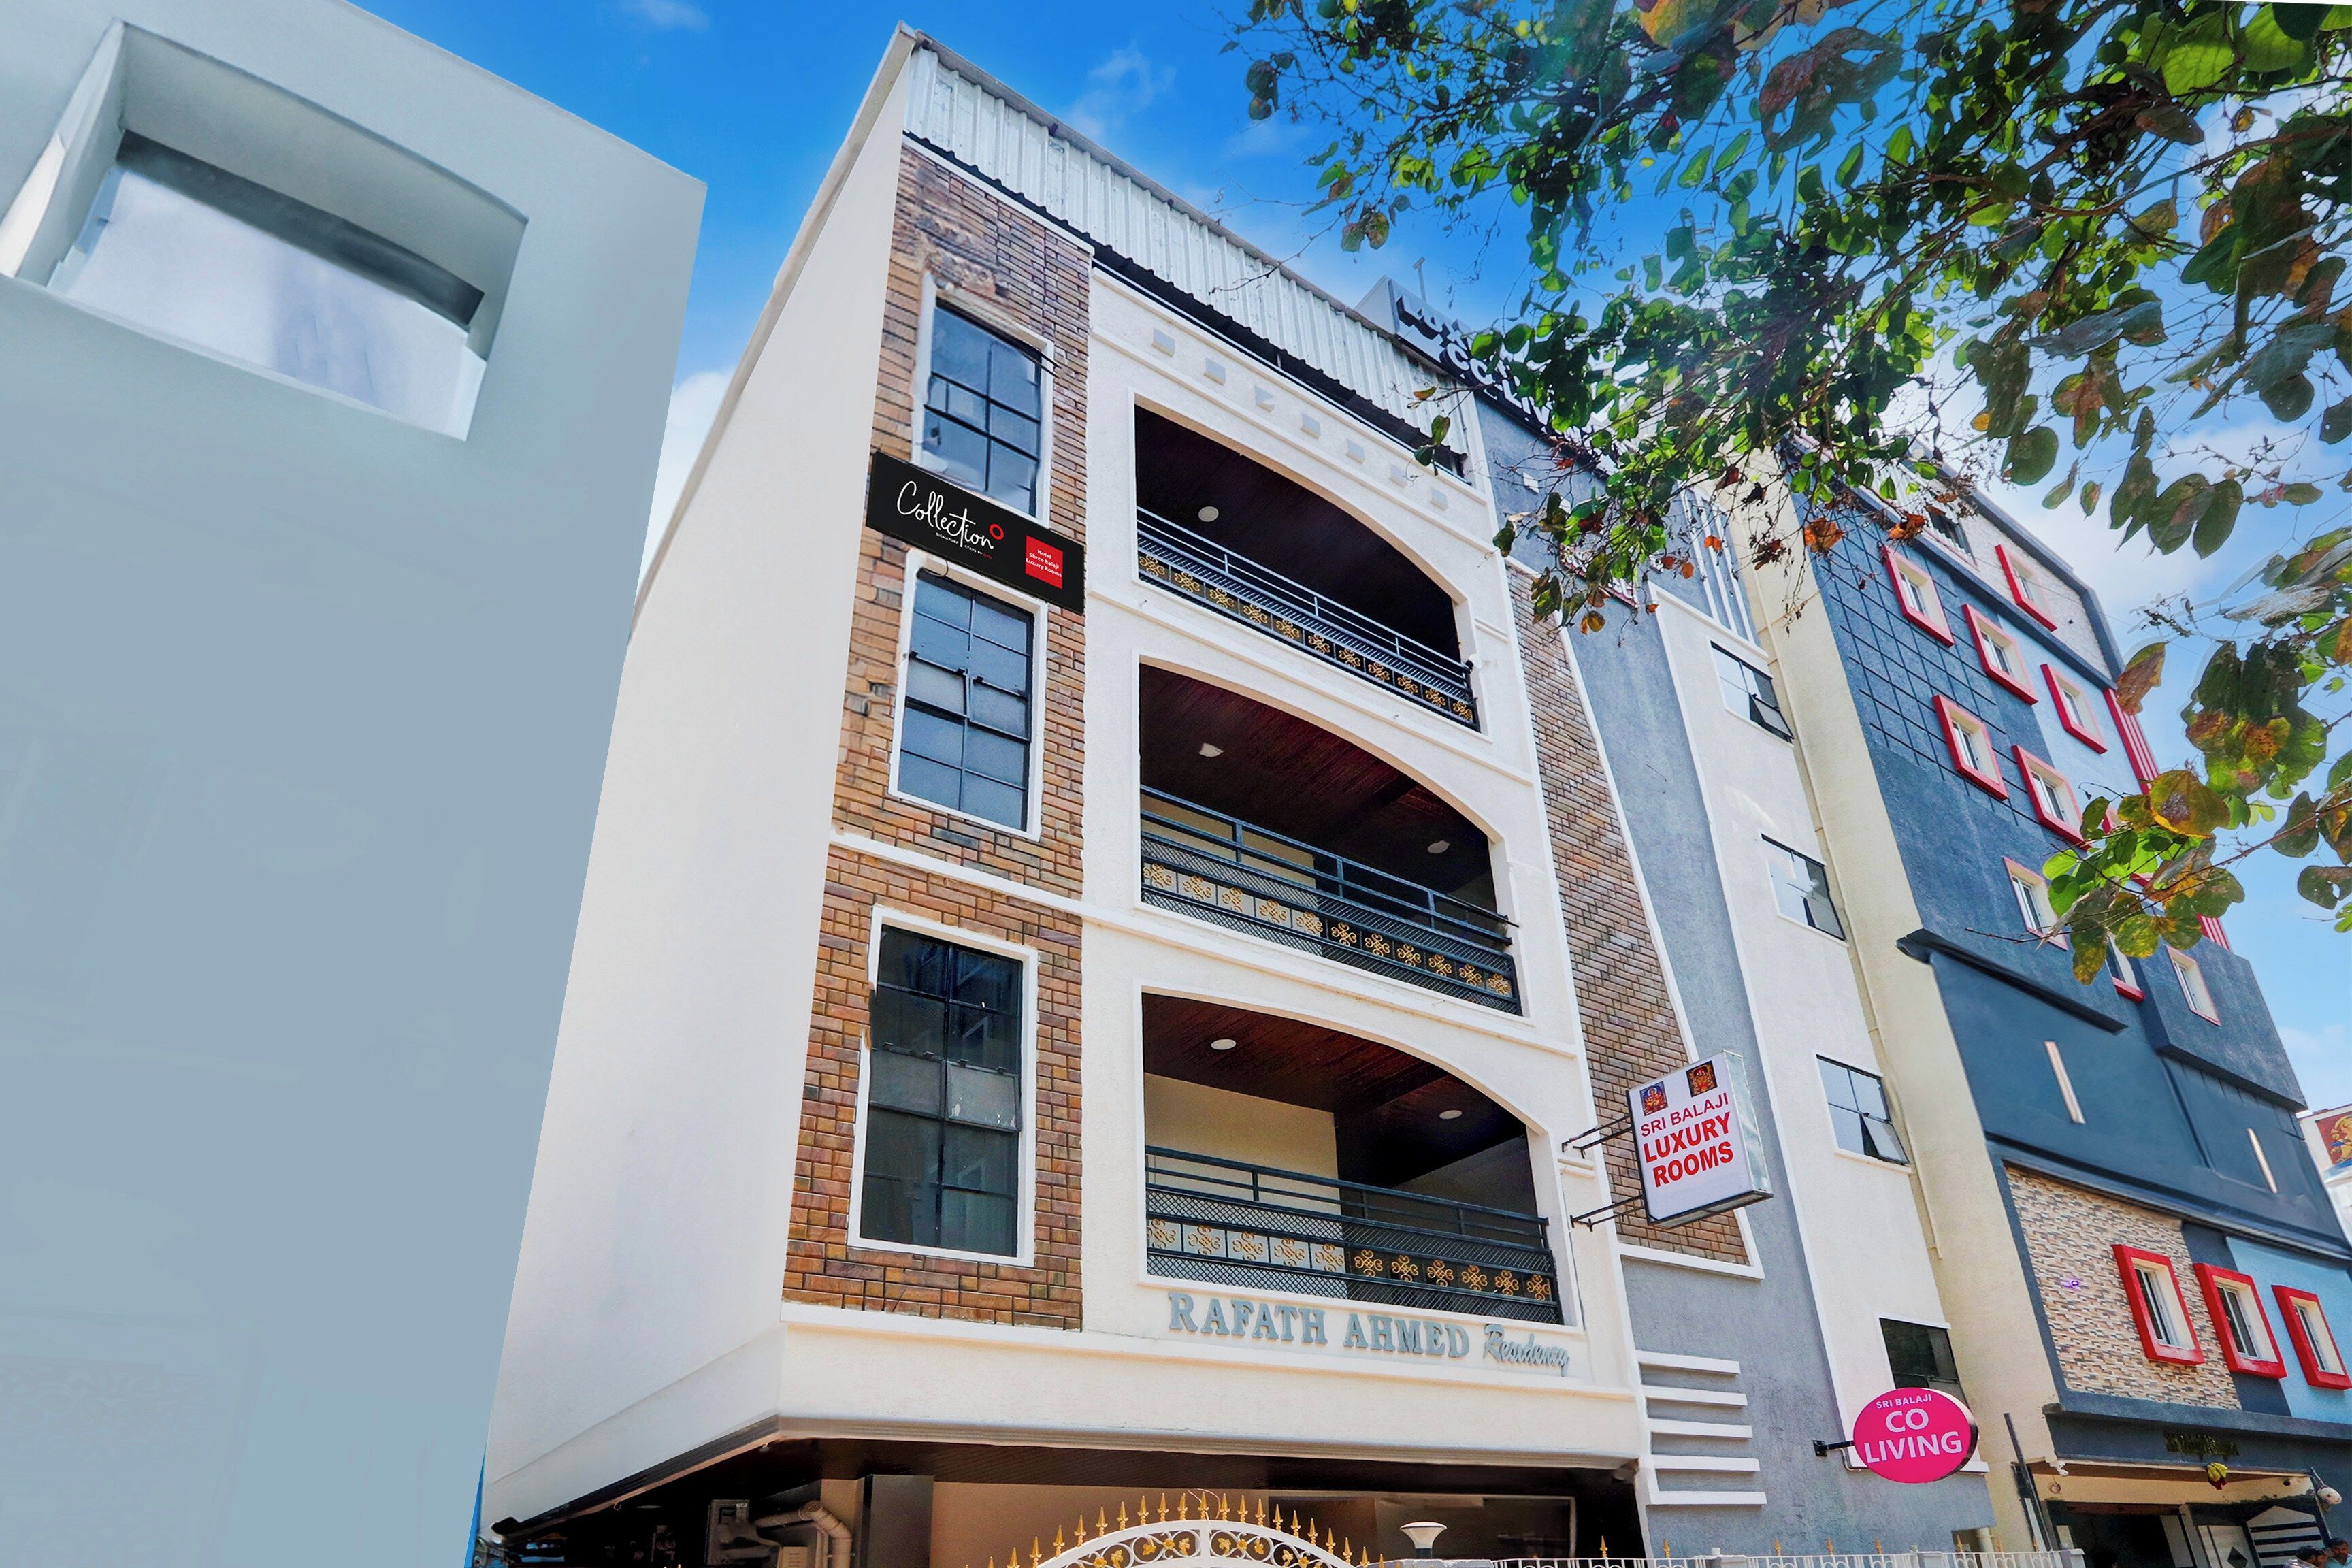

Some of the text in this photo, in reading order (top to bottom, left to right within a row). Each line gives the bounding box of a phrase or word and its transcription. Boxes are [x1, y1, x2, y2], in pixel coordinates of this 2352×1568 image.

[897, 480, 994, 550] Collection
[1026, 557, 1062, 578] Luxury Rooms
[1029, 552, 1060, 570] Shree Balaji
[1037, 549, 1052, 559] Hotel
[1640, 1092, 1729, 1137] SRI BALAJI
[1643, 1111, 1731, 1163] LUXURY
[1652, 1141, 1734, 1188] ROOMS
[1168, 1292, 1570, 1377] RAFATH AHMED Residency
[1876, 1393, 1932, 1409] SRI BALAJI
[1885, 1408, 1929, 1433] CO
[1864, 1431, 1963, 1463] LIVING
